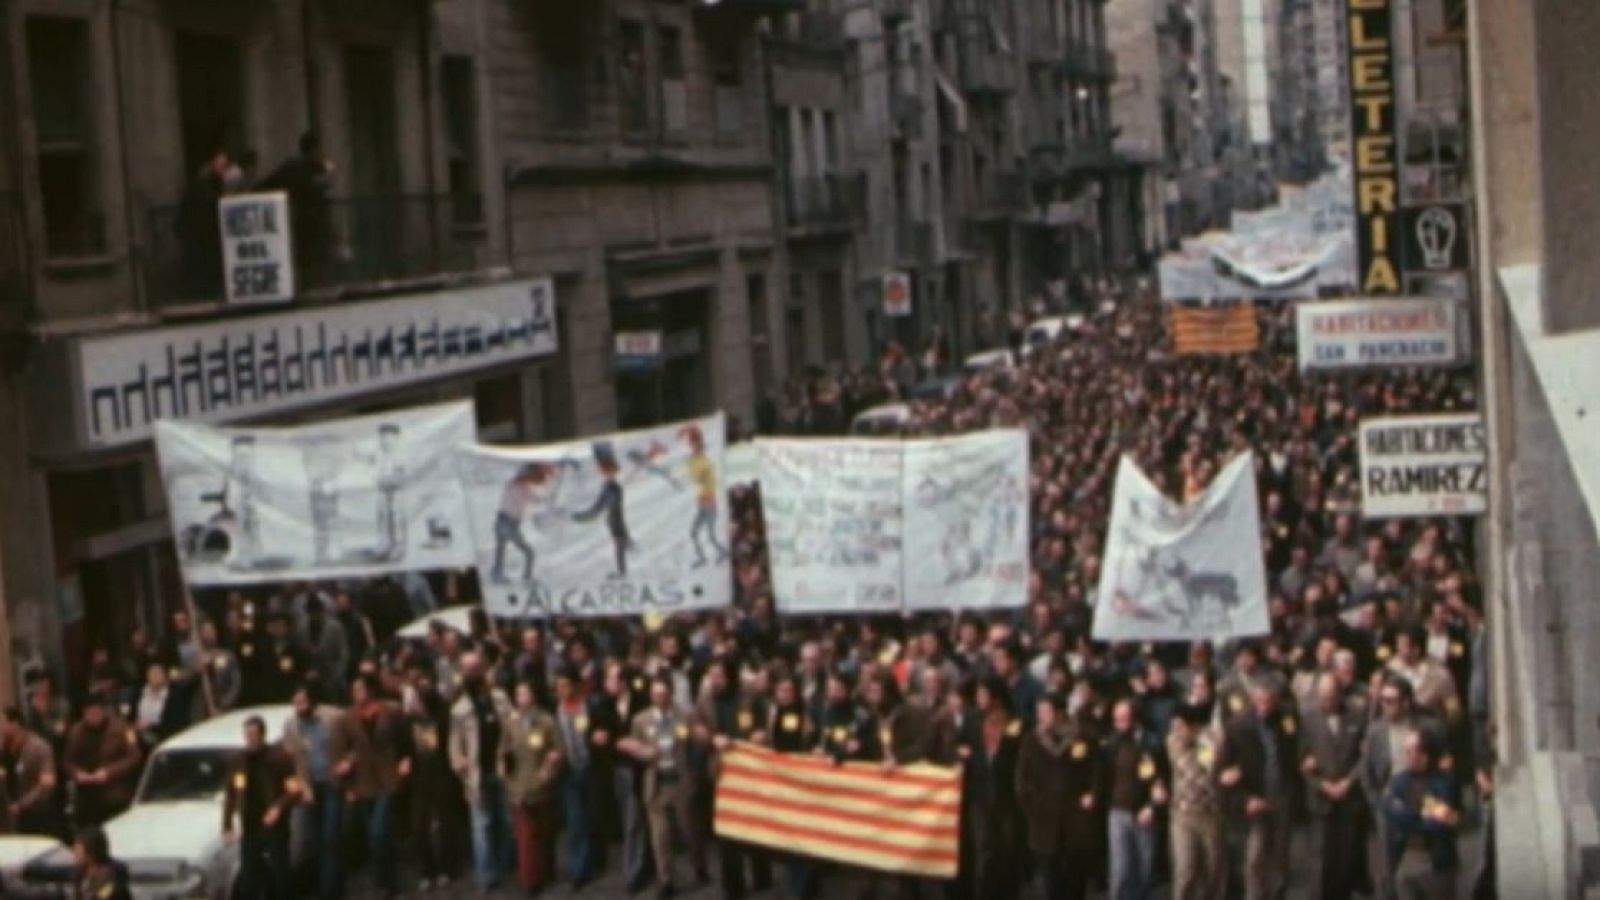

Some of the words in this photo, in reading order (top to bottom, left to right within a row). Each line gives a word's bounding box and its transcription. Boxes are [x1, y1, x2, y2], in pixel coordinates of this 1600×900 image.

[1349, 0, 1400, 292] LETERIA
[233, 264, 281, 298] SEGRE
[1315, 342, 1345, 361] SAN
[1368, 464, 1486, 496] RAMIREZ
